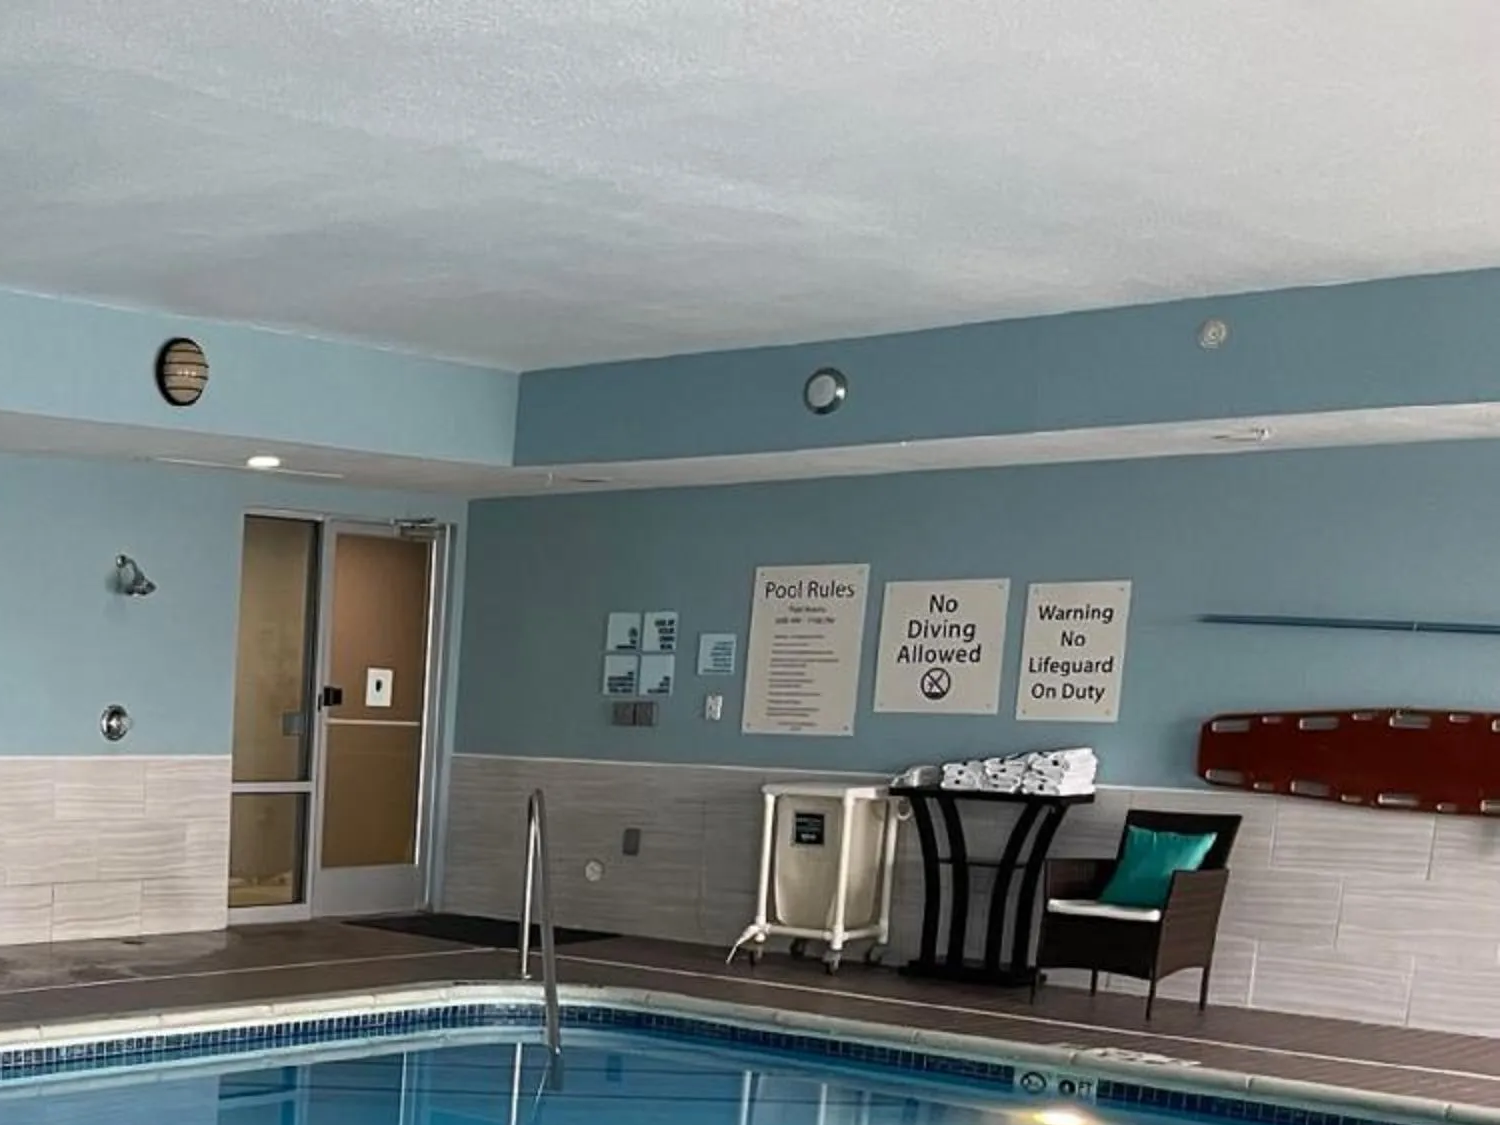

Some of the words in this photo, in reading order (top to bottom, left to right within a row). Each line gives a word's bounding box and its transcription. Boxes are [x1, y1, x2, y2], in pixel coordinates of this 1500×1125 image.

[765, 580, 803, 599] Pool
[807, 580, 855, 599] Rules
[929, 594, 959, 613] No
[1038, 604, 1114, 624] Warning
[908, 619, 976, 642] Diving
[1060, 630, 1086, 647] No
[897, 644, 982, 663] Allowed
[1028, 656, 1114, 677] Lifeguard
[1031, 683, 1057, 699] On
[1061, 683, 1105, 704] Duty
